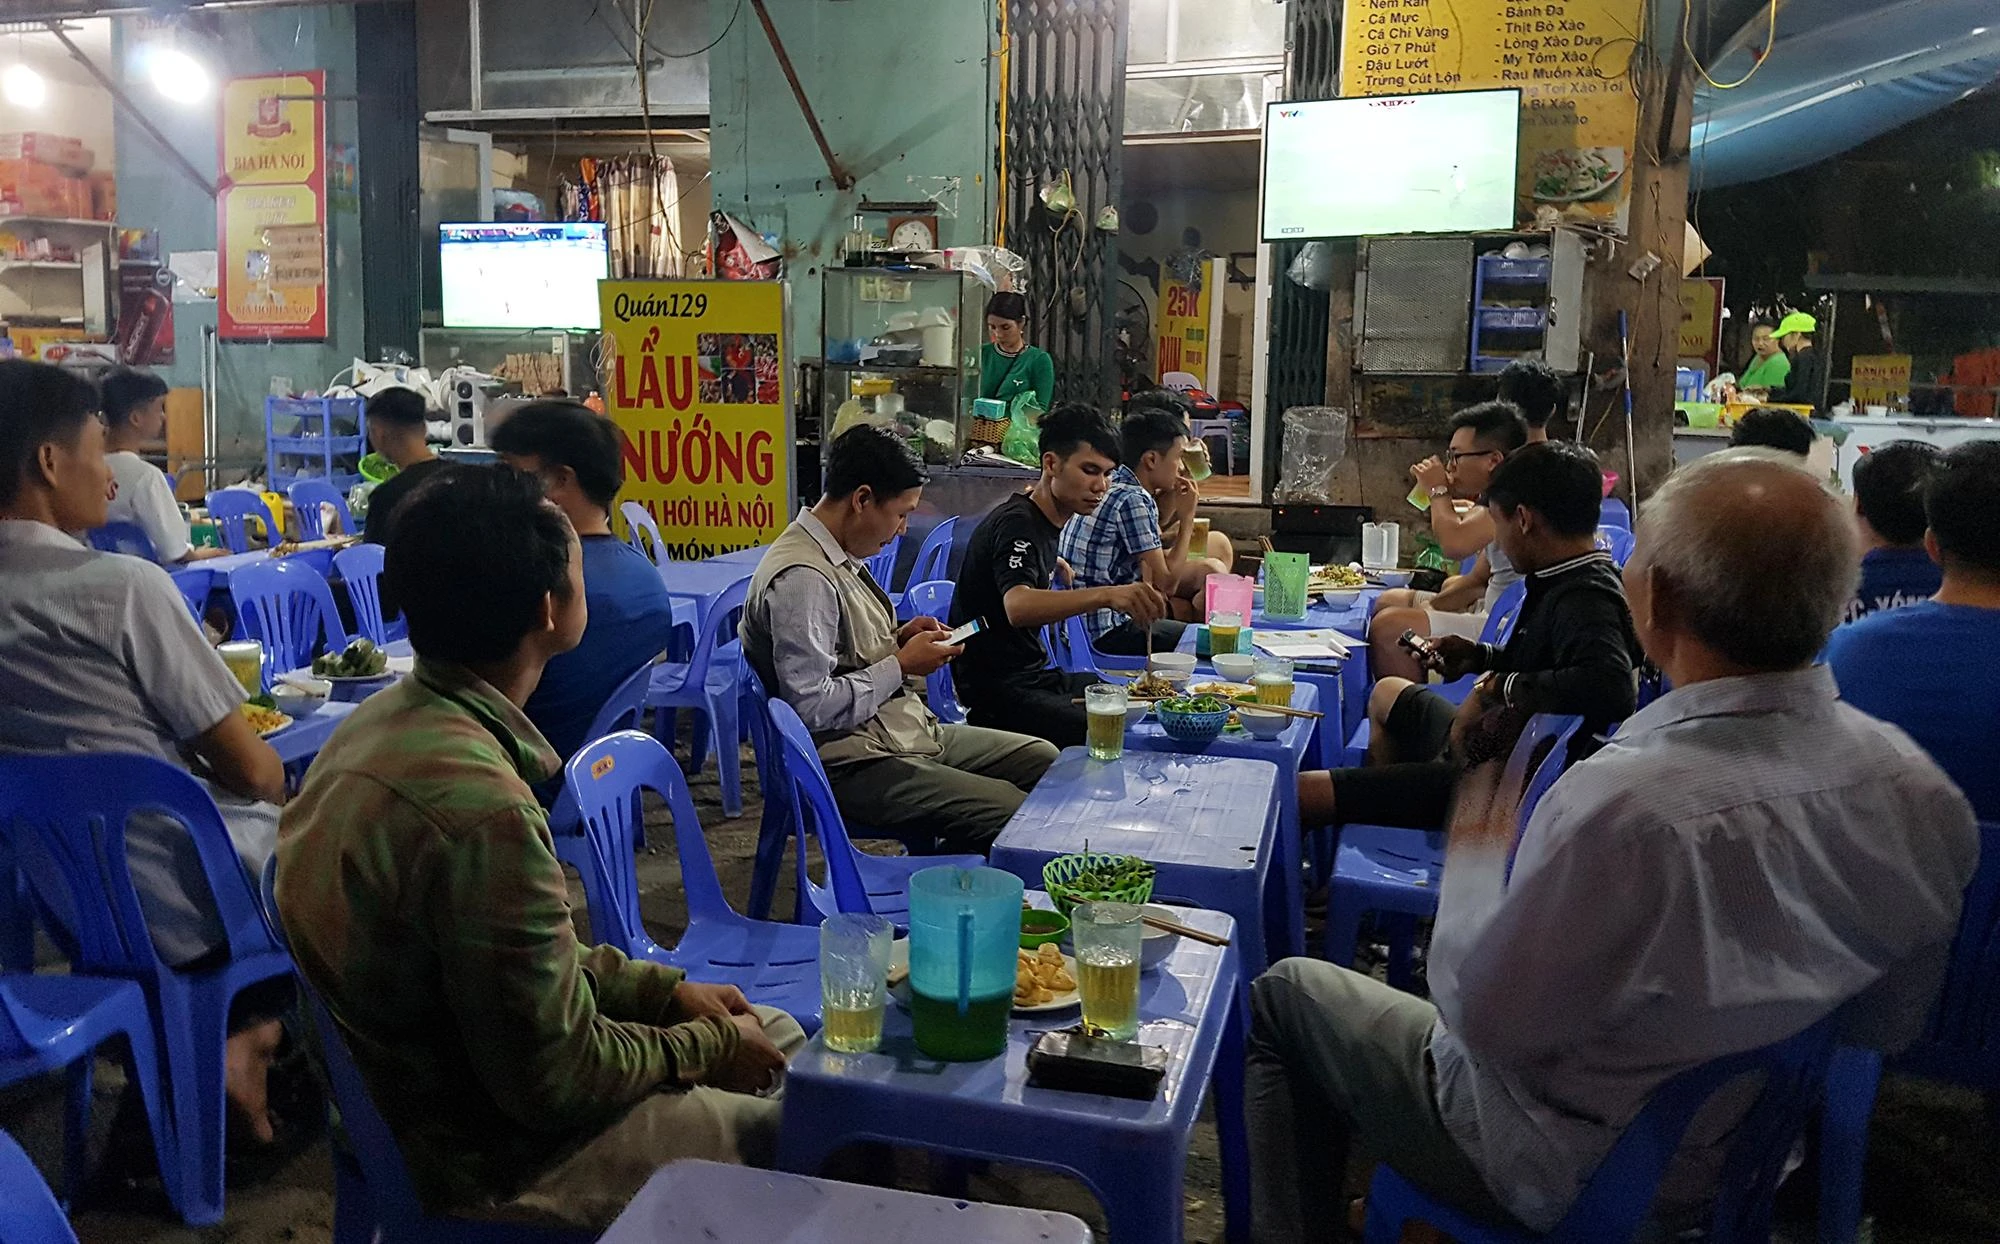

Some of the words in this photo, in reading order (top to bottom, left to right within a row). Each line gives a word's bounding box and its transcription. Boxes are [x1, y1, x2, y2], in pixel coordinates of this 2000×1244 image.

[1368, 13, 1385, 25] Cá
[1390, 12, 1419, 26] Mực
[1367, 28, 1385, 40] Cá
[1416, 25, 1449, 39] Vàng
[1505, 21, 1531, 35] Thịt
[1394, 43, 1401, 54] 7
[1405, 42, 1436, 54] Phút
[1504, 38, 1539, 51] Lòng
[1527, 51, 1557, 64] Tôm
[1366, 59, 1391, 73] Đậu
[1365, 73, 1404, 88] Trứng
[1408, 72, 1431, 85] Cút
[1435, 71, 1461, 85] Lộn
[1502, 69, 1528, 81] Rau
[614, 292, 708, 323] Quán129
[615, 325, 693, 411] LẨU
[621, 413, 774, 486] NƯỚNG
[663, 494, 699, 527] HƠI
[705, 492, 733, 528] HÀ
[738, 493, 774, 536] NỘI
[667, 537, 715, 561] MÓN
